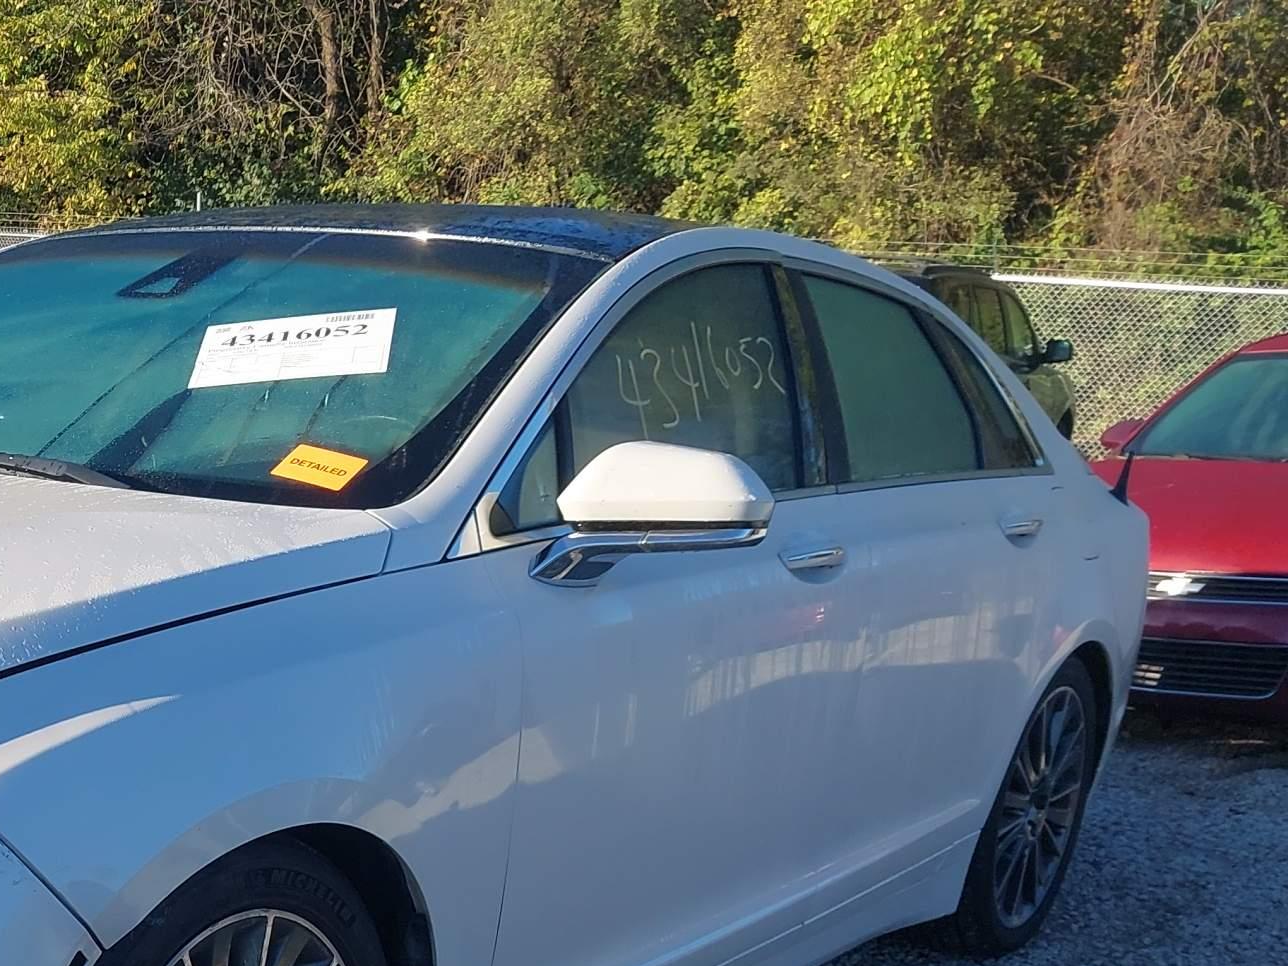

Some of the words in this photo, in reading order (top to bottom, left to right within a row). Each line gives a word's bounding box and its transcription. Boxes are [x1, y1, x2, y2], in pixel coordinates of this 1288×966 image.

[220, 323, 369, 347] 43416052
[615, 320, 787, 440] 43416052
[289, 457, 348, 477] DETAILED
